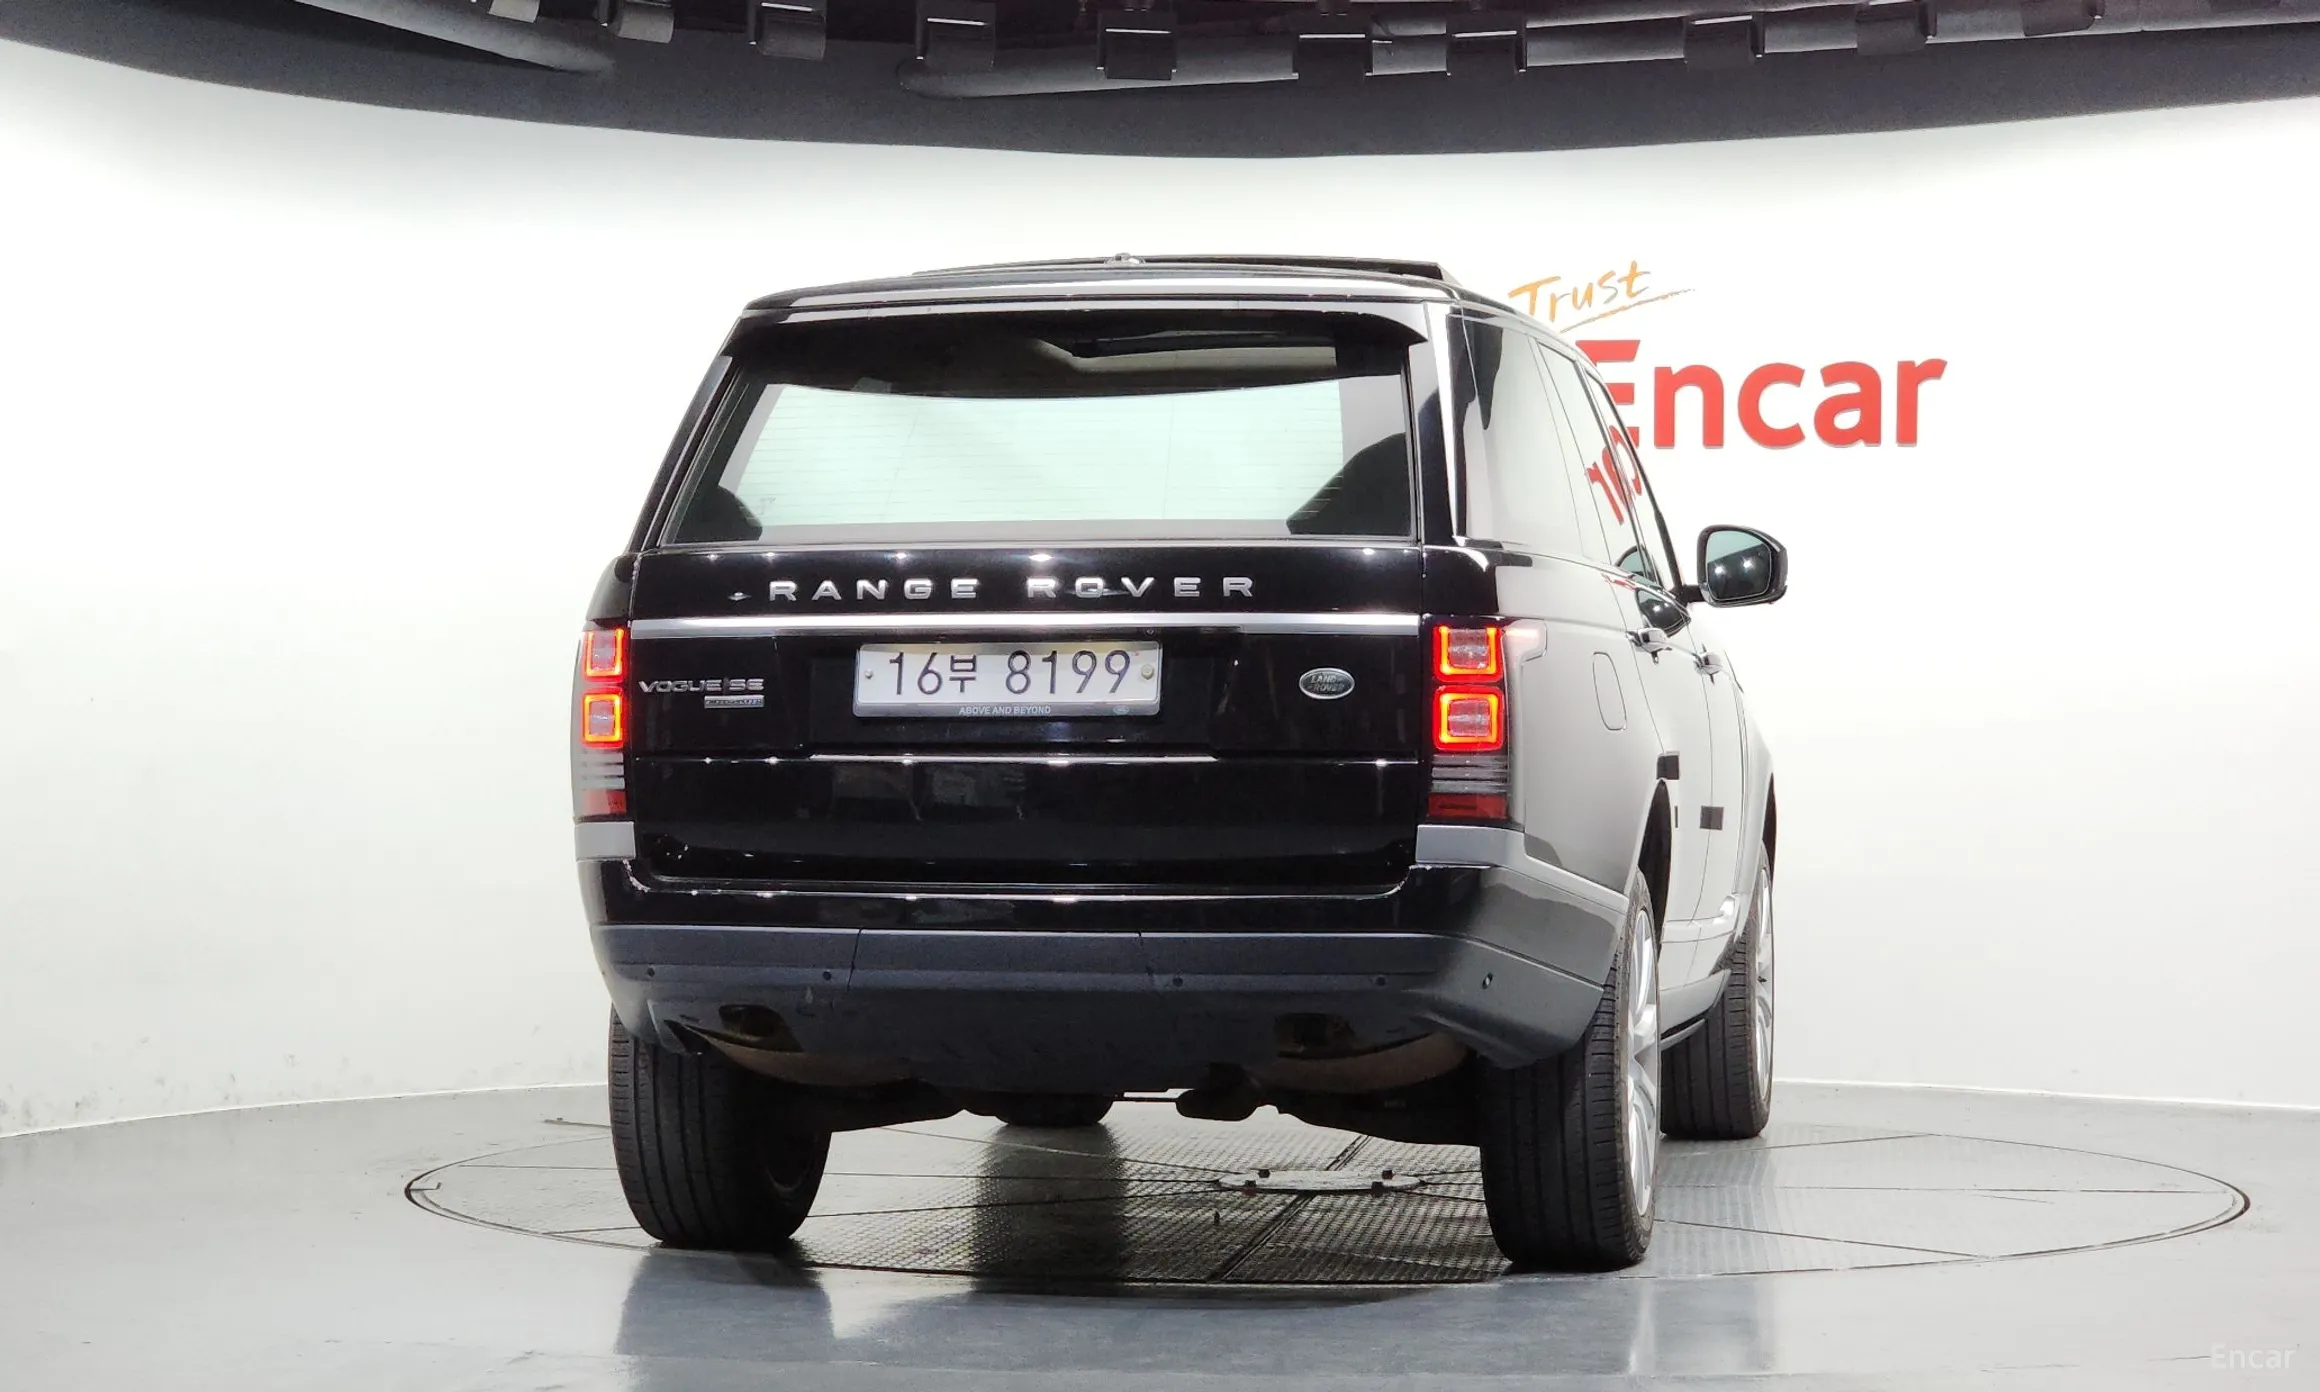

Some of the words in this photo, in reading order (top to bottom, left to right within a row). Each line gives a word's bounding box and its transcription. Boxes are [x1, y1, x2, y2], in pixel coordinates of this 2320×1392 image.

[1508, 260, 1651, 323] Trust
[769, 578, 979, 601] RANGE
[1027, 576, 1253, 599] ROVER
[888, 651, 977, 695] 16부
[1004, 649, 1131, 695] 8199
[639, 680, 722, 693] VOGUE
[729, 678, 764, 691] SE
[958, 706, 991, 716] ABOVE
[993, 706, 1012, 715] AND
[1014, 705, 1051, 715] BEYOND
